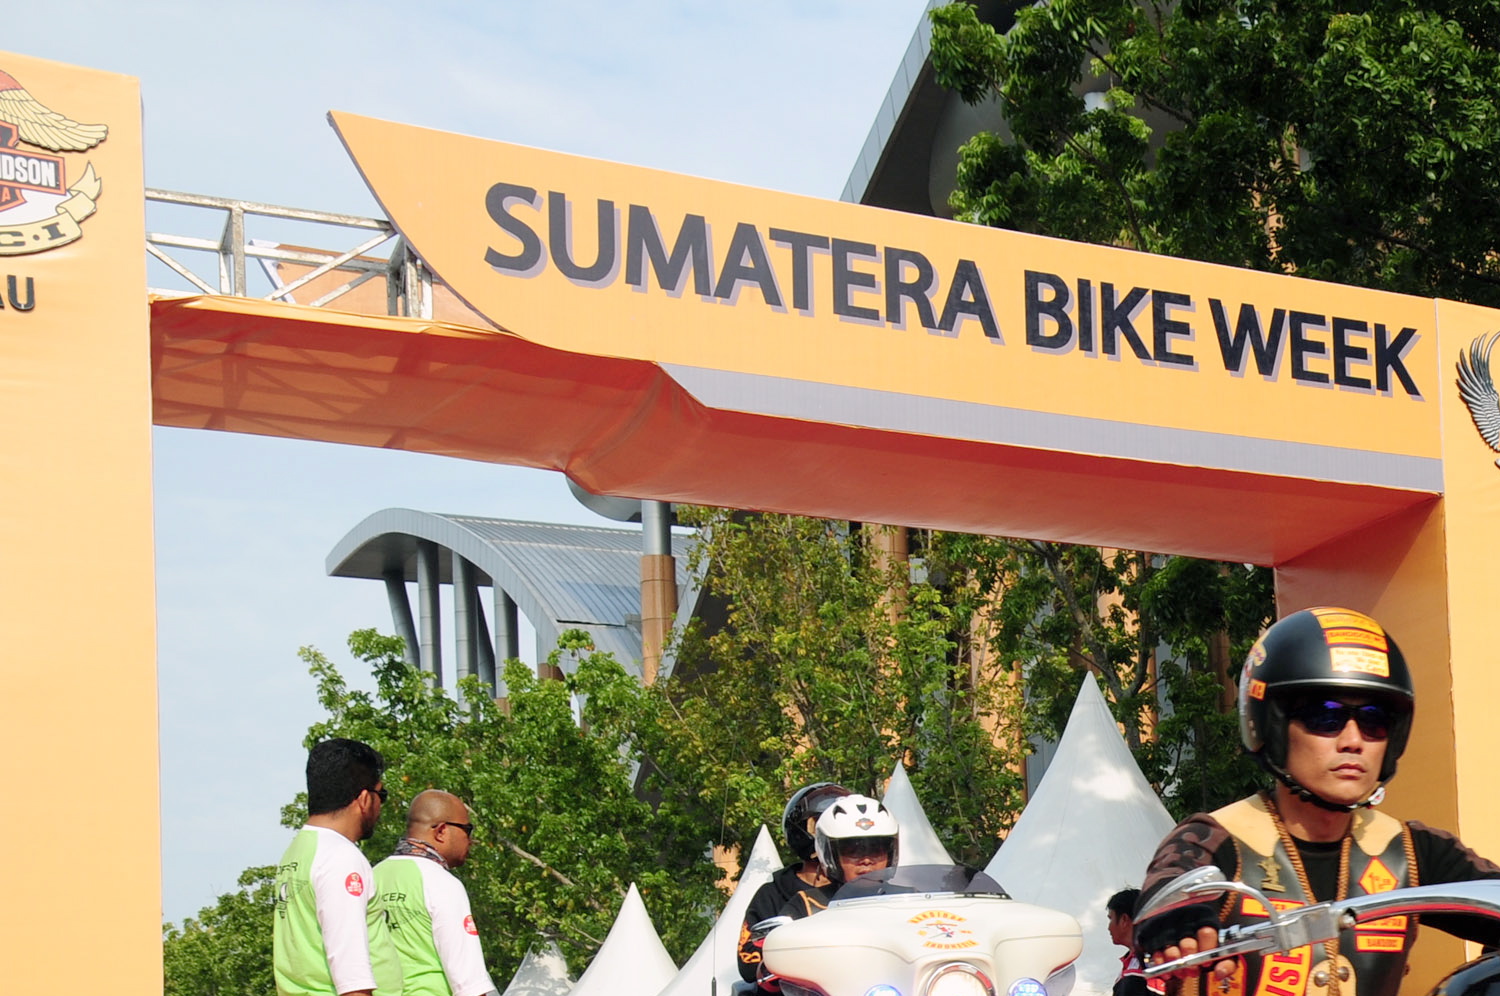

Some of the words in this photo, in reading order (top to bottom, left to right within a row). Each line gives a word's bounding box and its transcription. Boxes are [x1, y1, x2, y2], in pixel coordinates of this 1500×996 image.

[484, 181, 999, 343] SUMATERA
[1024, 268, 1197, 369] BIKE
[1208, 296, 1422, 400] WEEK
